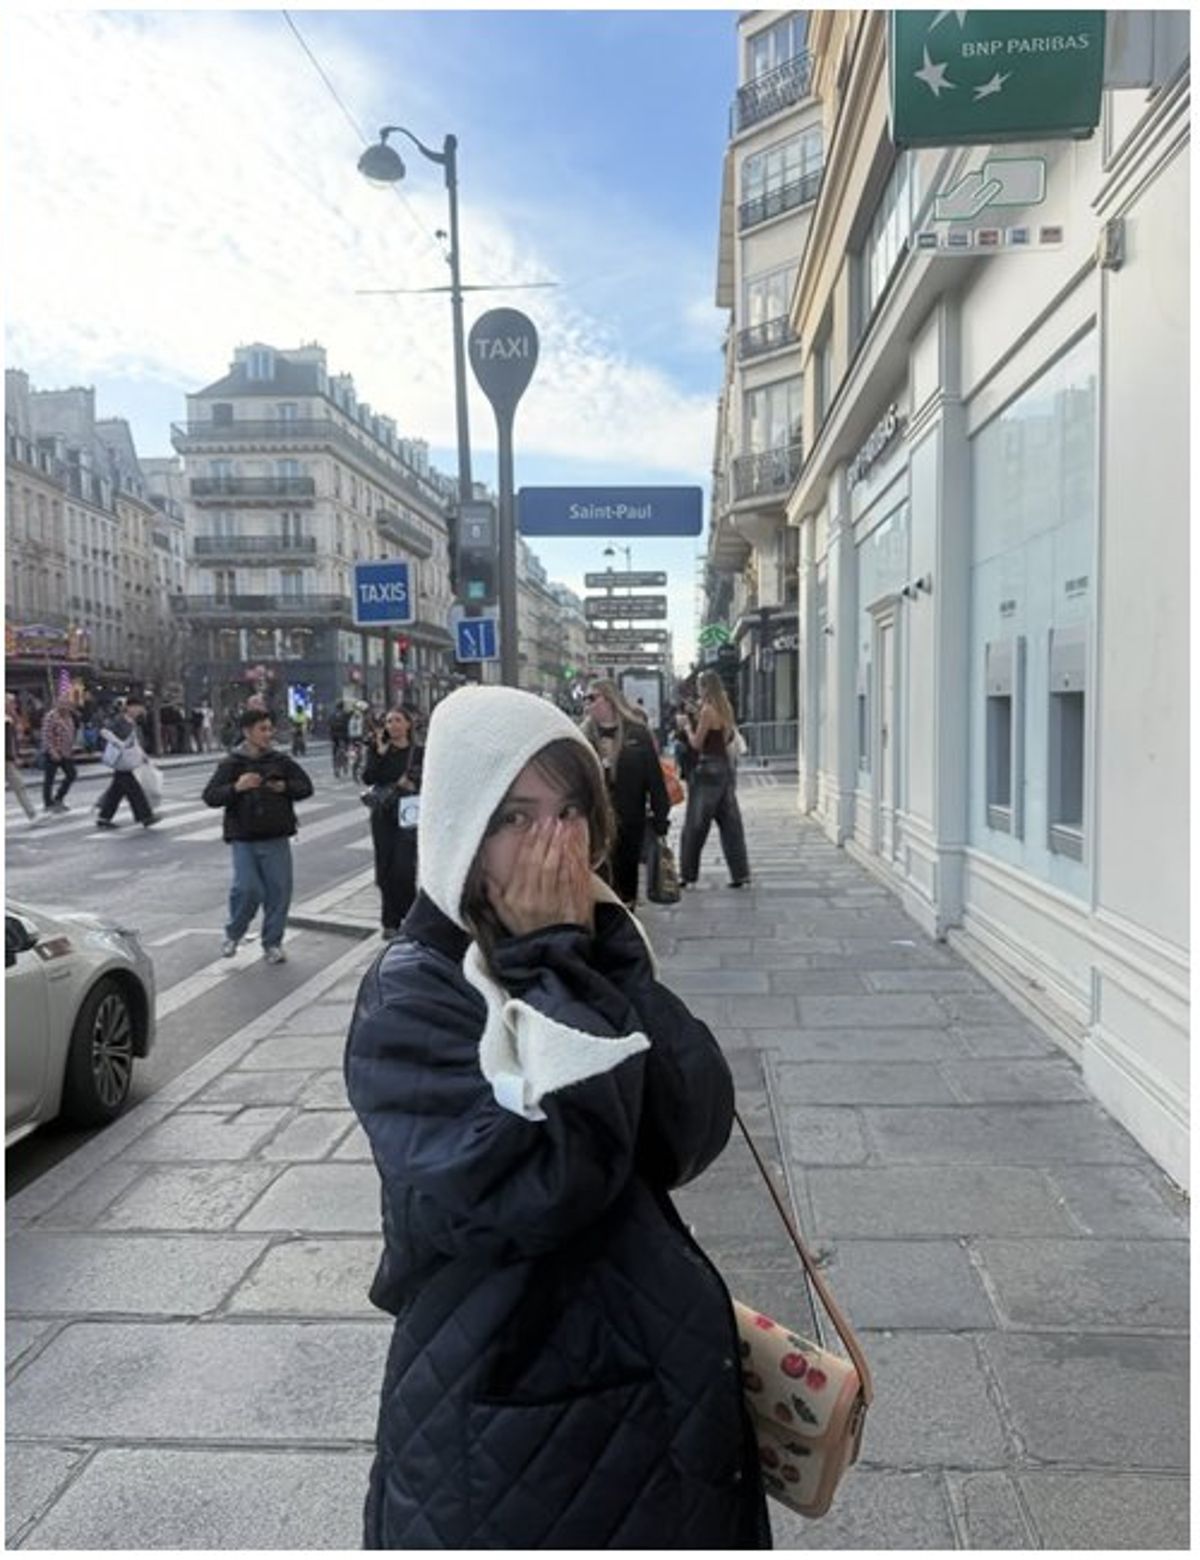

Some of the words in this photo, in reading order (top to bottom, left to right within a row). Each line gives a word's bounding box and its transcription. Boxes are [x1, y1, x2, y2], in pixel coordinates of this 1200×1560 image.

[961, 40, 1002, 58] BNP
[1007, 33, 1089, 54] PARIBAS
[474, 336, 529, 359] TAXI
[568, 503, 652, 520] Saint-Paul
[359, 582, 407, 603] TAXIS
